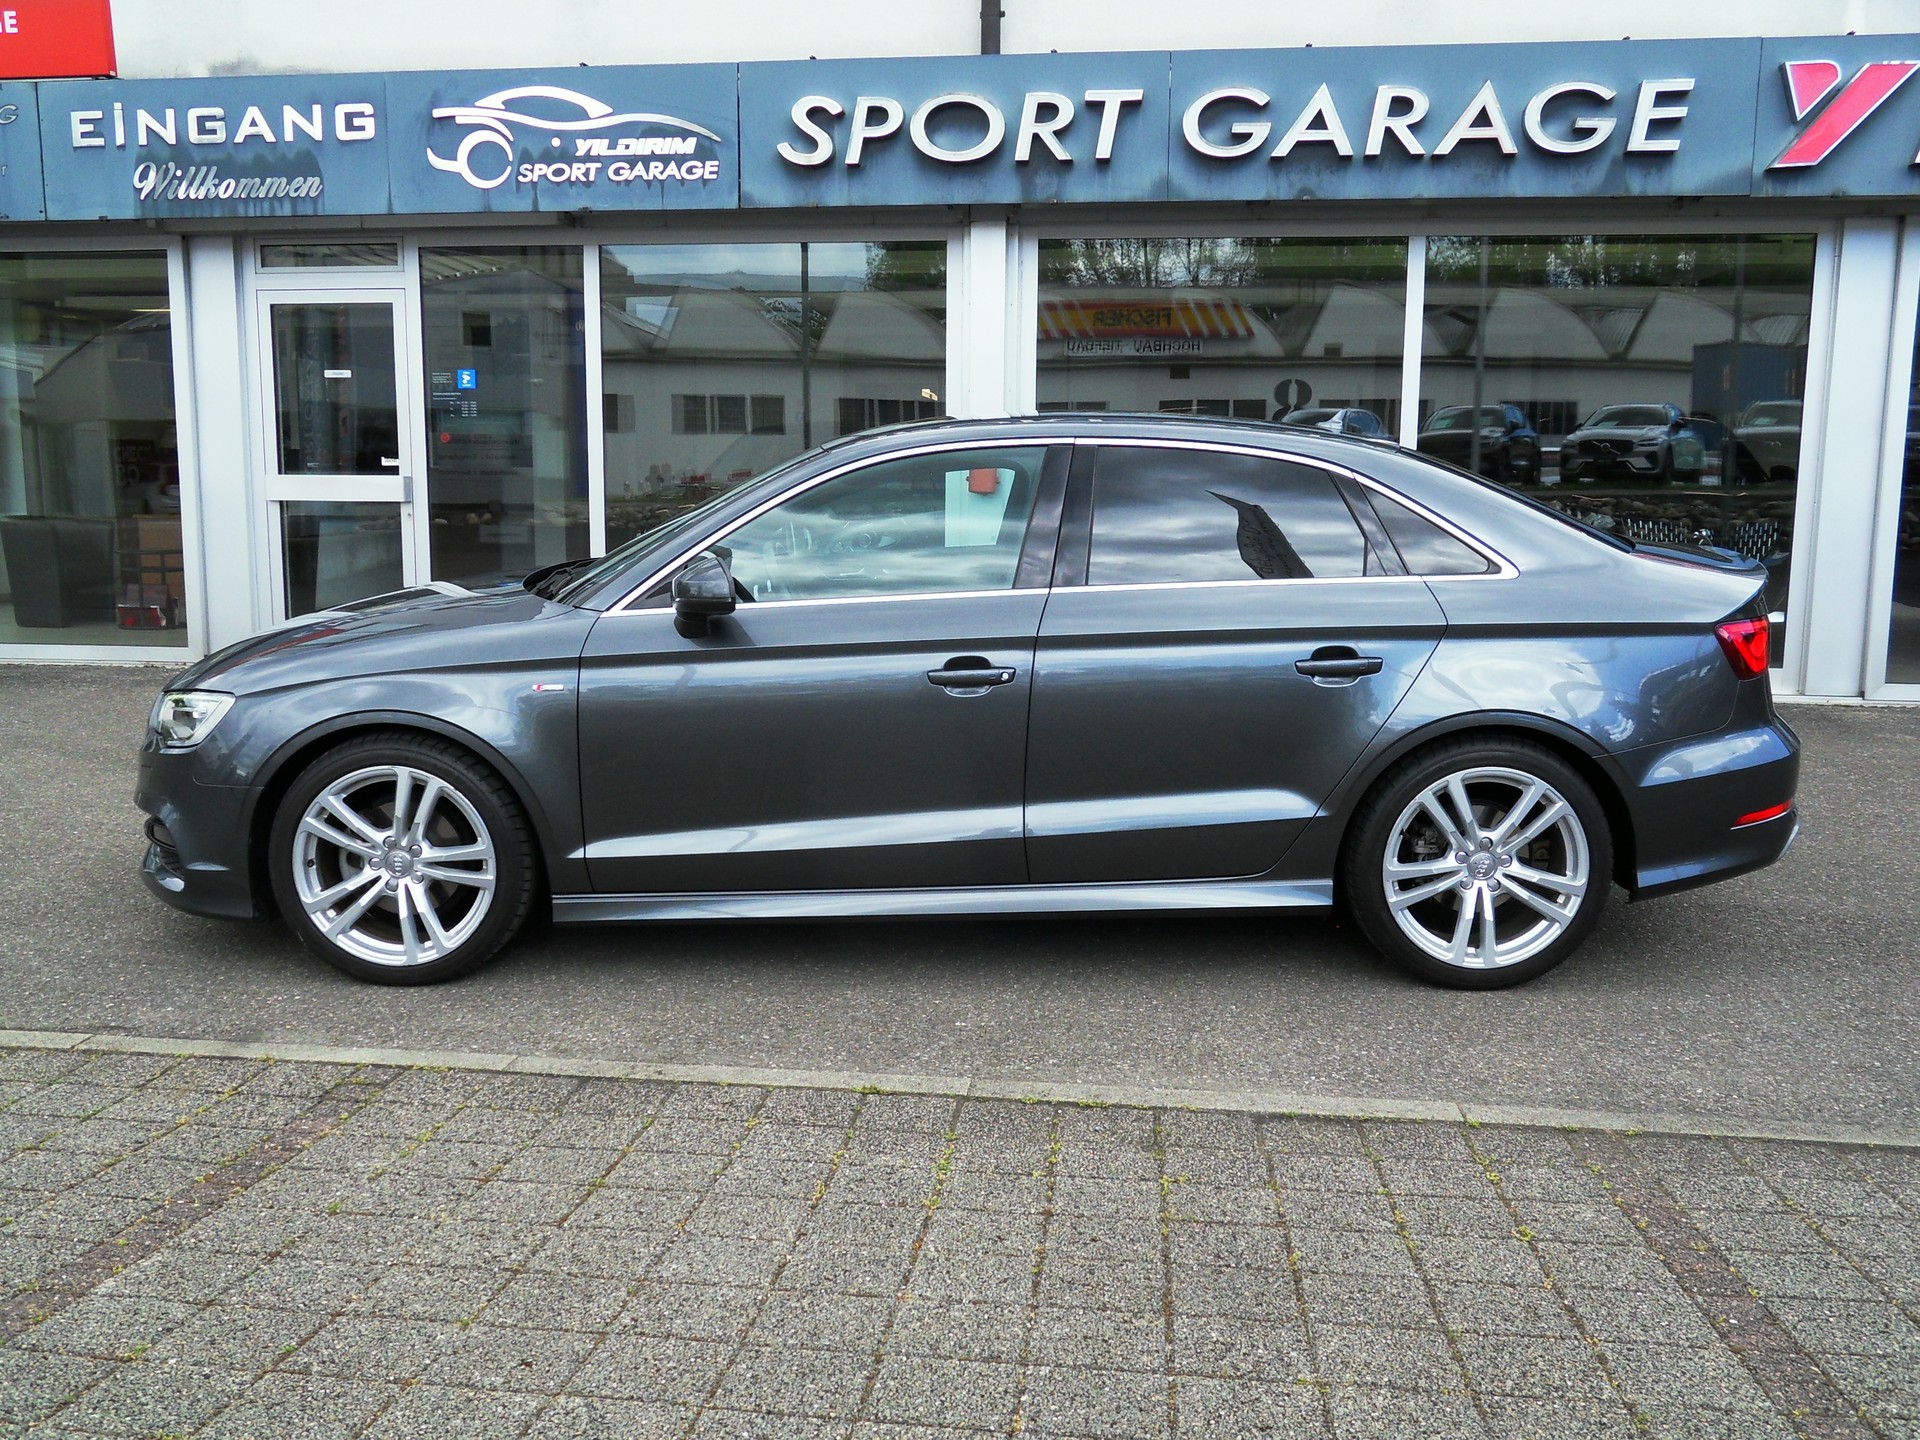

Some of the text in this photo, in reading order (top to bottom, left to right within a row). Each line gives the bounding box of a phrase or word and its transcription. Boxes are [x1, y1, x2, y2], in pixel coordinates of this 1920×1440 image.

[0, 11, 18, 34] E
[776, 78, 1695, 166] SPORT GARAGE
[575, 137, 697, 156] YILDIRIM
[133, 161, 323, 200] Willkommen
[517, 160, 720, 182] SPORT GARAGE
